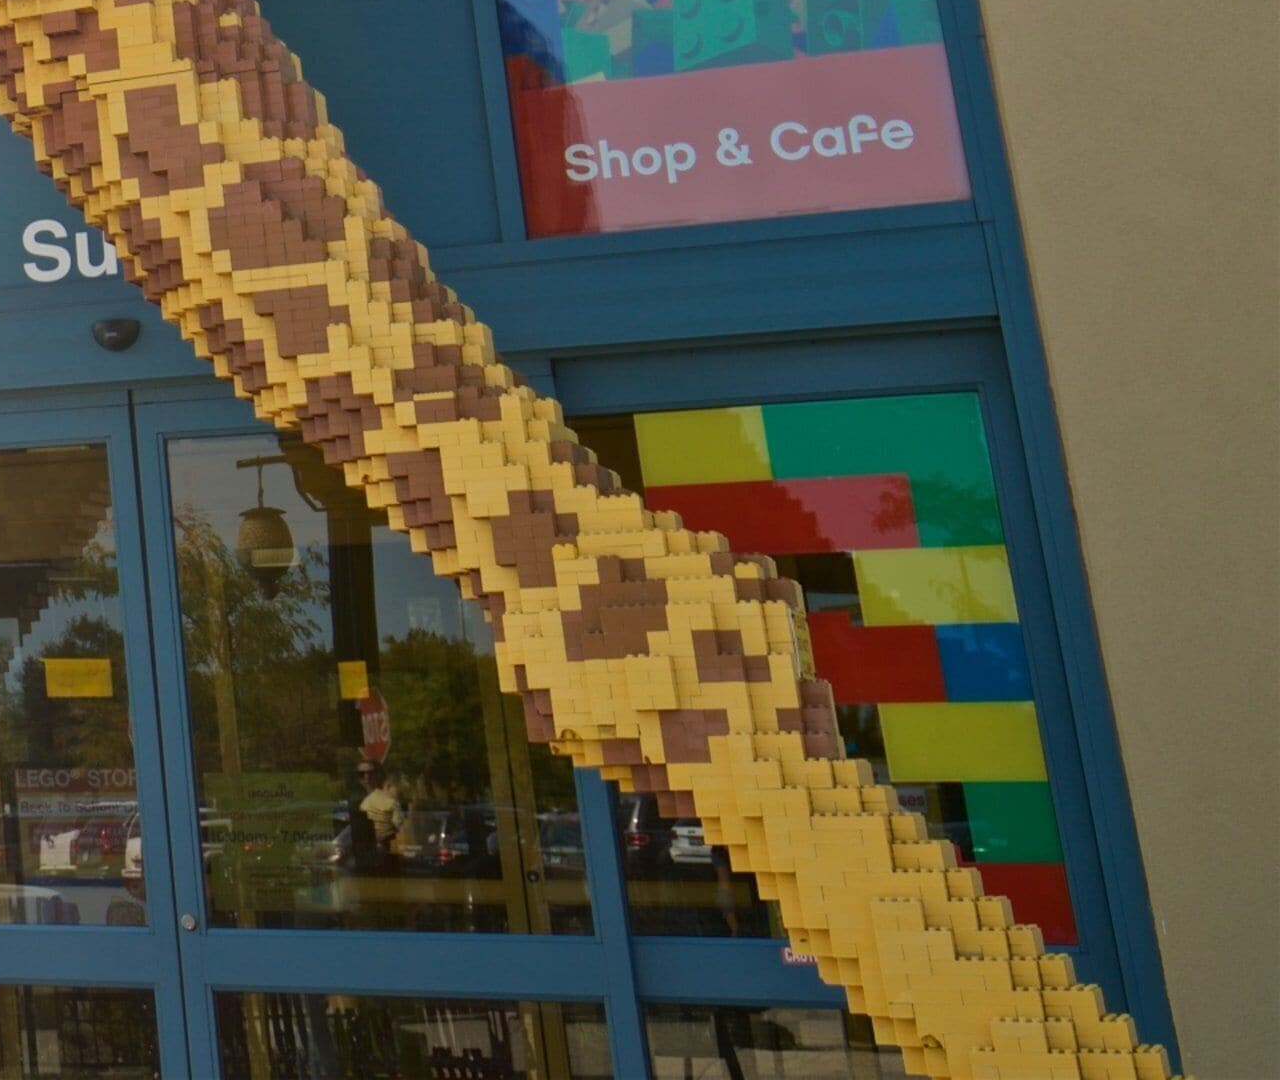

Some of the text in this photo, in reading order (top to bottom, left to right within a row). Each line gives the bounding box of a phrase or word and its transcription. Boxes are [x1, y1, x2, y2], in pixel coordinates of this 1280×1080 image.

[564, 114, 914, 184] Shop & Cafe
